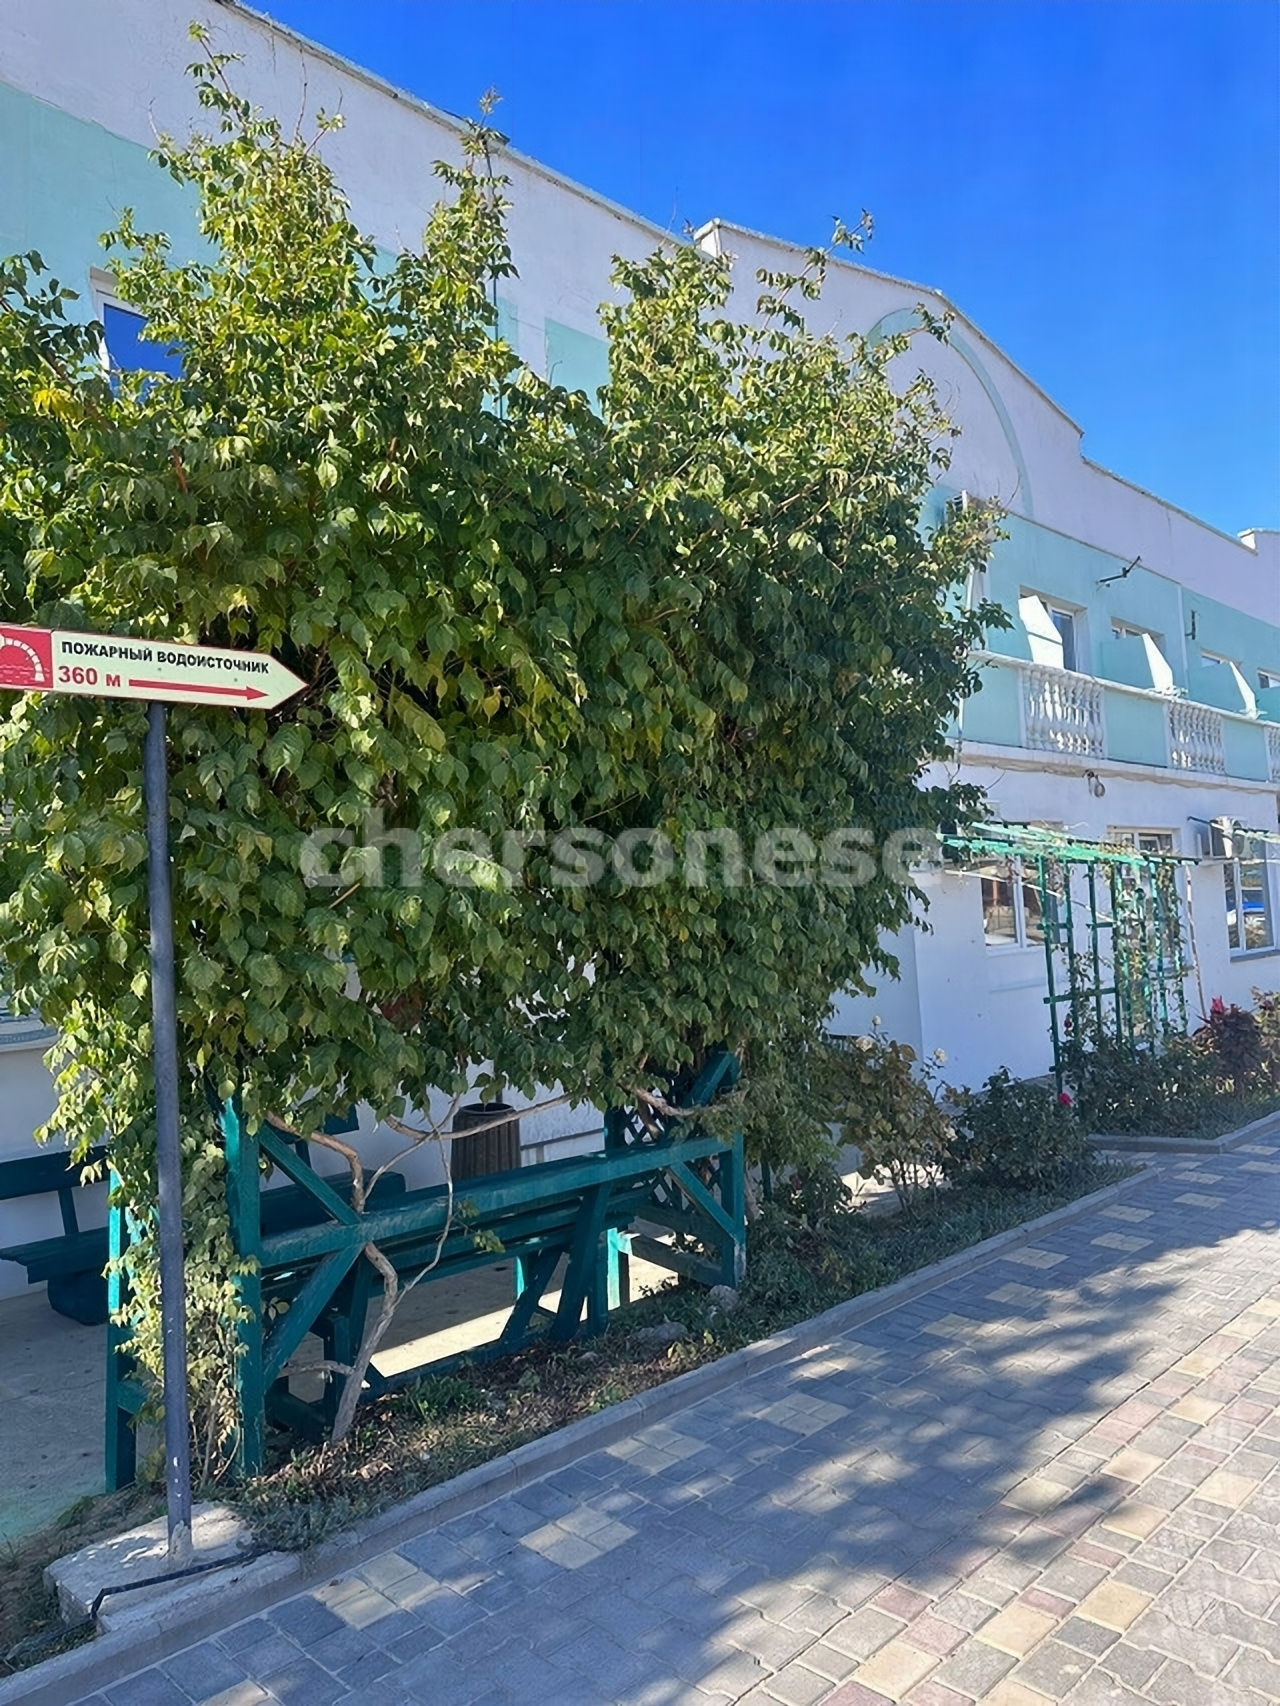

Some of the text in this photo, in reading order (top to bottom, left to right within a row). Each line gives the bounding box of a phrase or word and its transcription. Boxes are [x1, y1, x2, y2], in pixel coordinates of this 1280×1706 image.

[61, 641, 270, 674] ПОЖАРНЫЙ ВОДОИСТОЧНИК
[58, 666, 98, 686] 360
